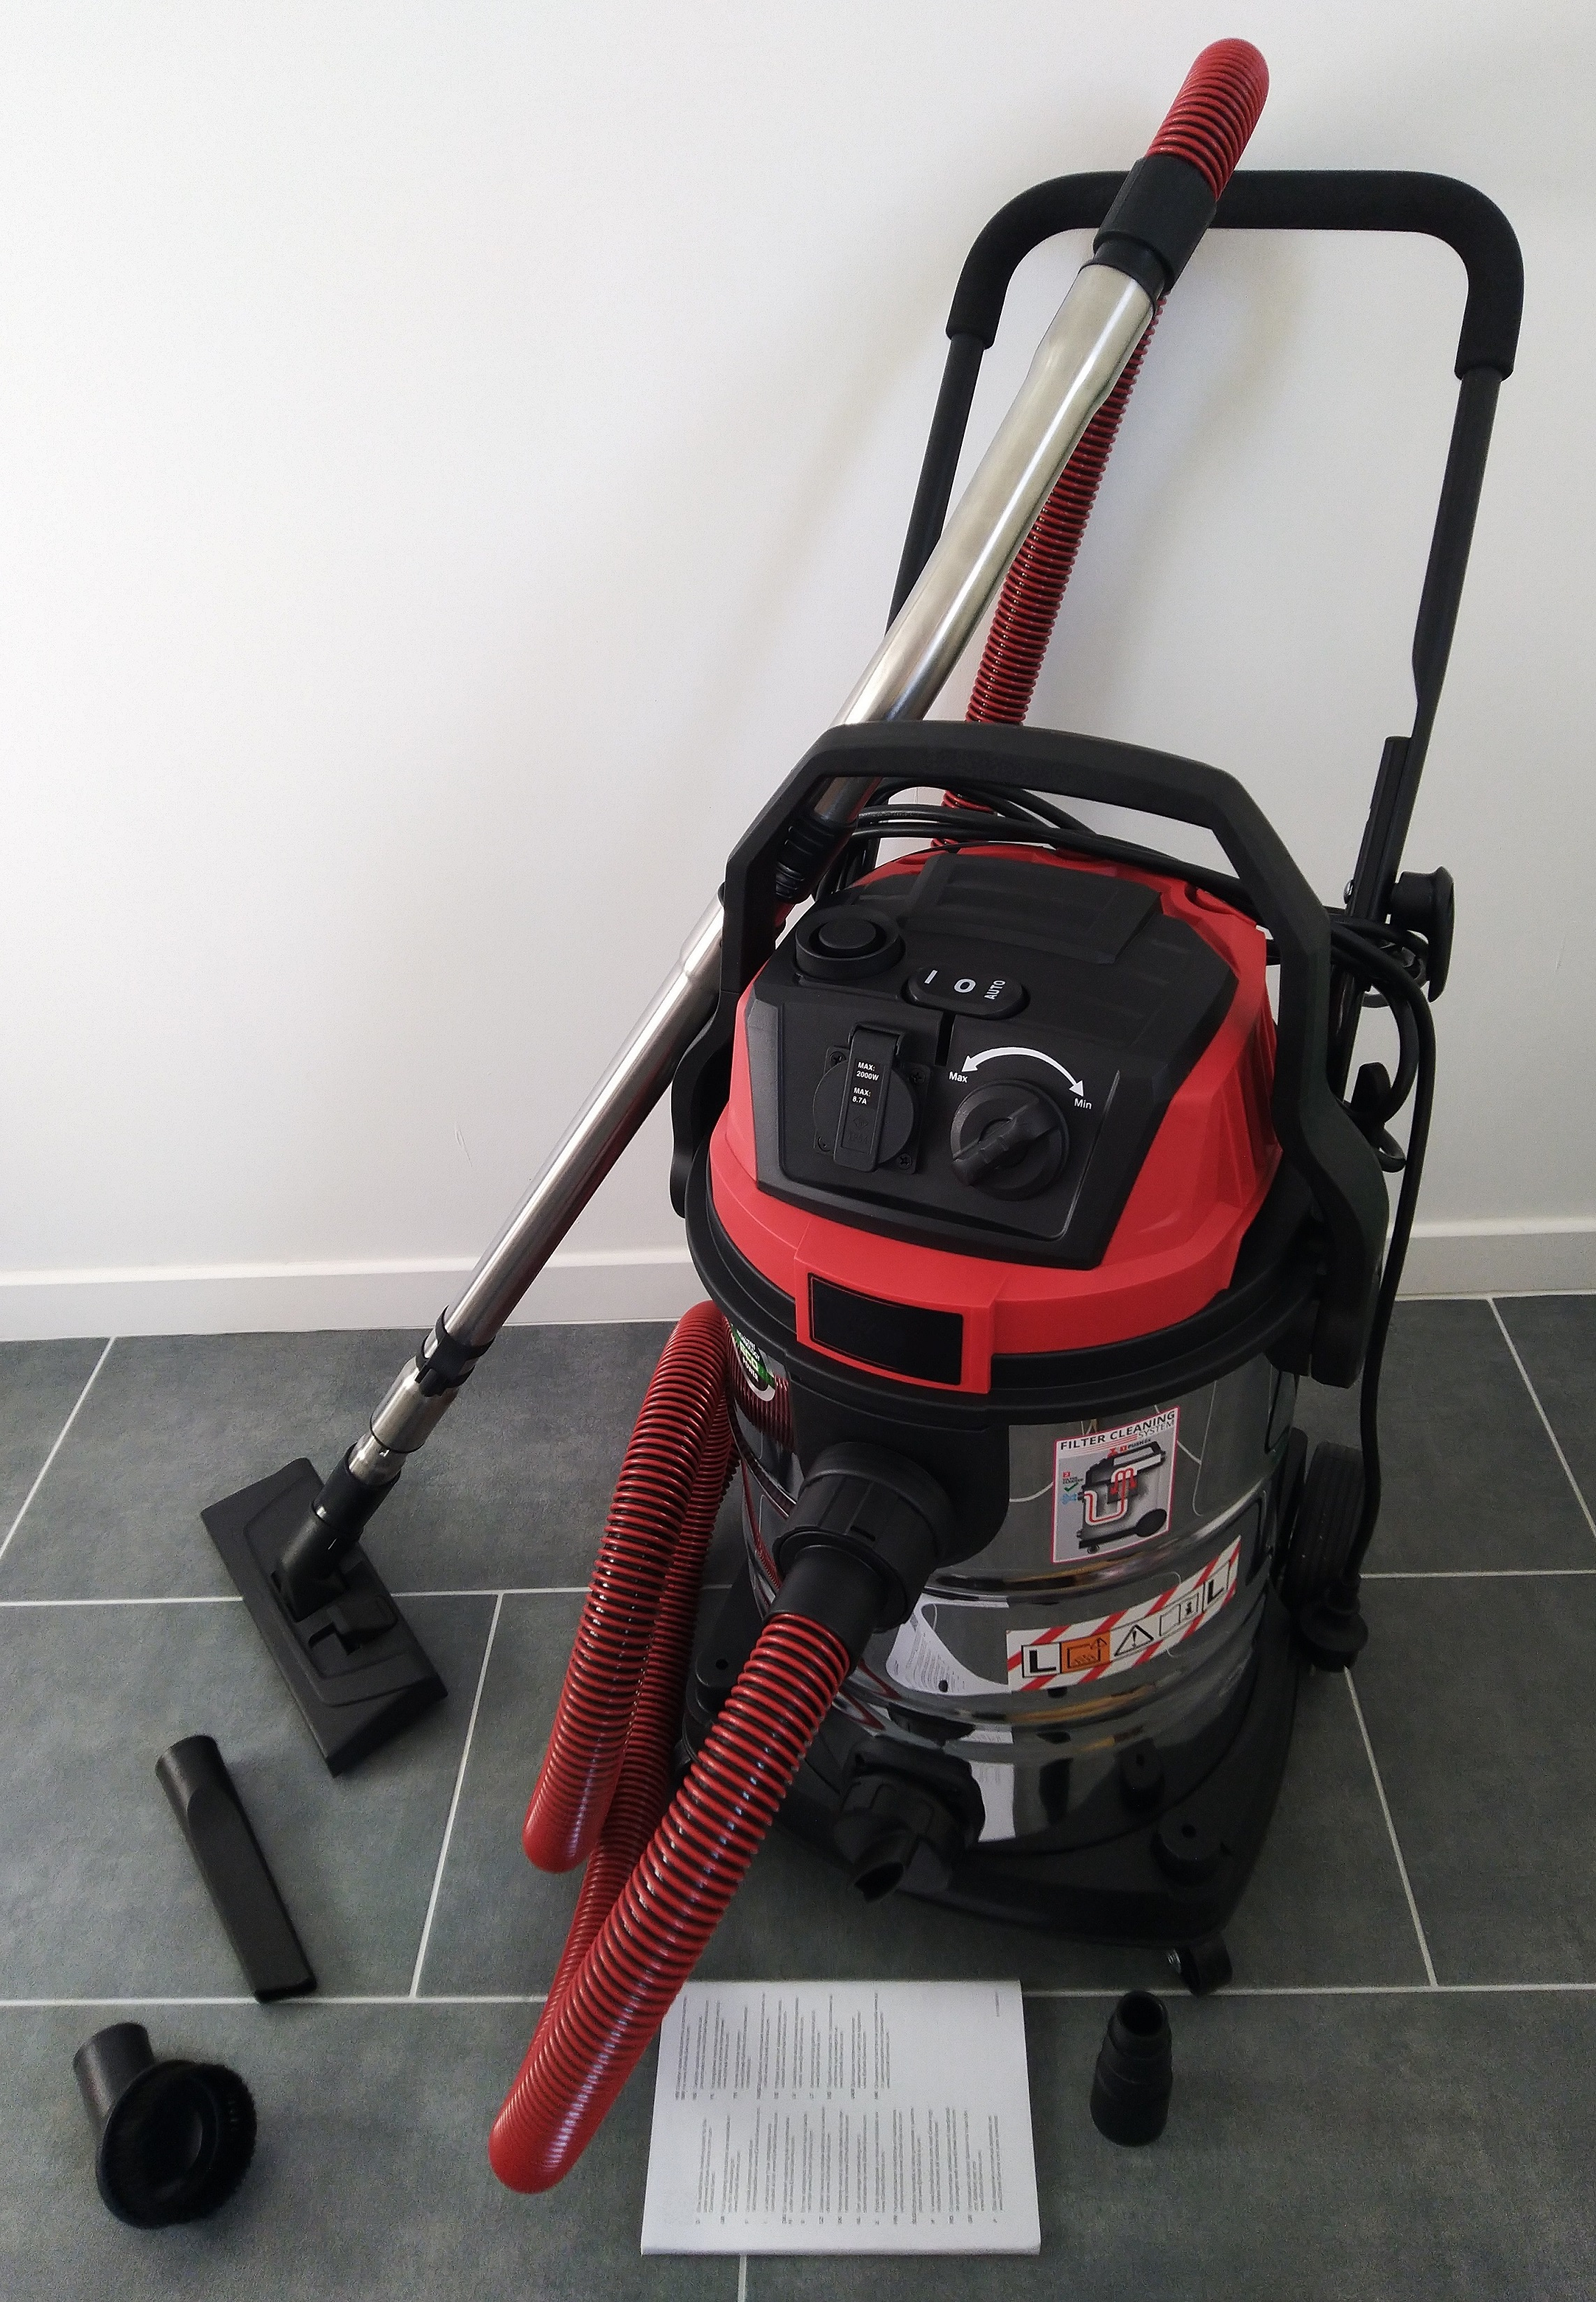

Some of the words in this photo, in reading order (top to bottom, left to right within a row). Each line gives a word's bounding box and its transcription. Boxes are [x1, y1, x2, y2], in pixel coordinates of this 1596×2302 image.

[983, 980, 1006, 1000] AUTO
[858, 1062, 876, 1071] MAX:
[856, 1070, 879, 1081] 2000W
[949, 1070, 968, 1083] Max
[854, 1087, 871, 1097] MAX:
[852, 1096, 867, 1105] 8.7A
[1074, 1097, 1092, 1110] Min
[1060, 1435, 1105, 1450] FILTER
[1109, 1410, 1176, 1440] CLEANING
[1137, 1418, 1175, 1439] SYSTEM
[1208, 1580, 1224, 1604] L
[1029, 1650, 1057, 1673] L
